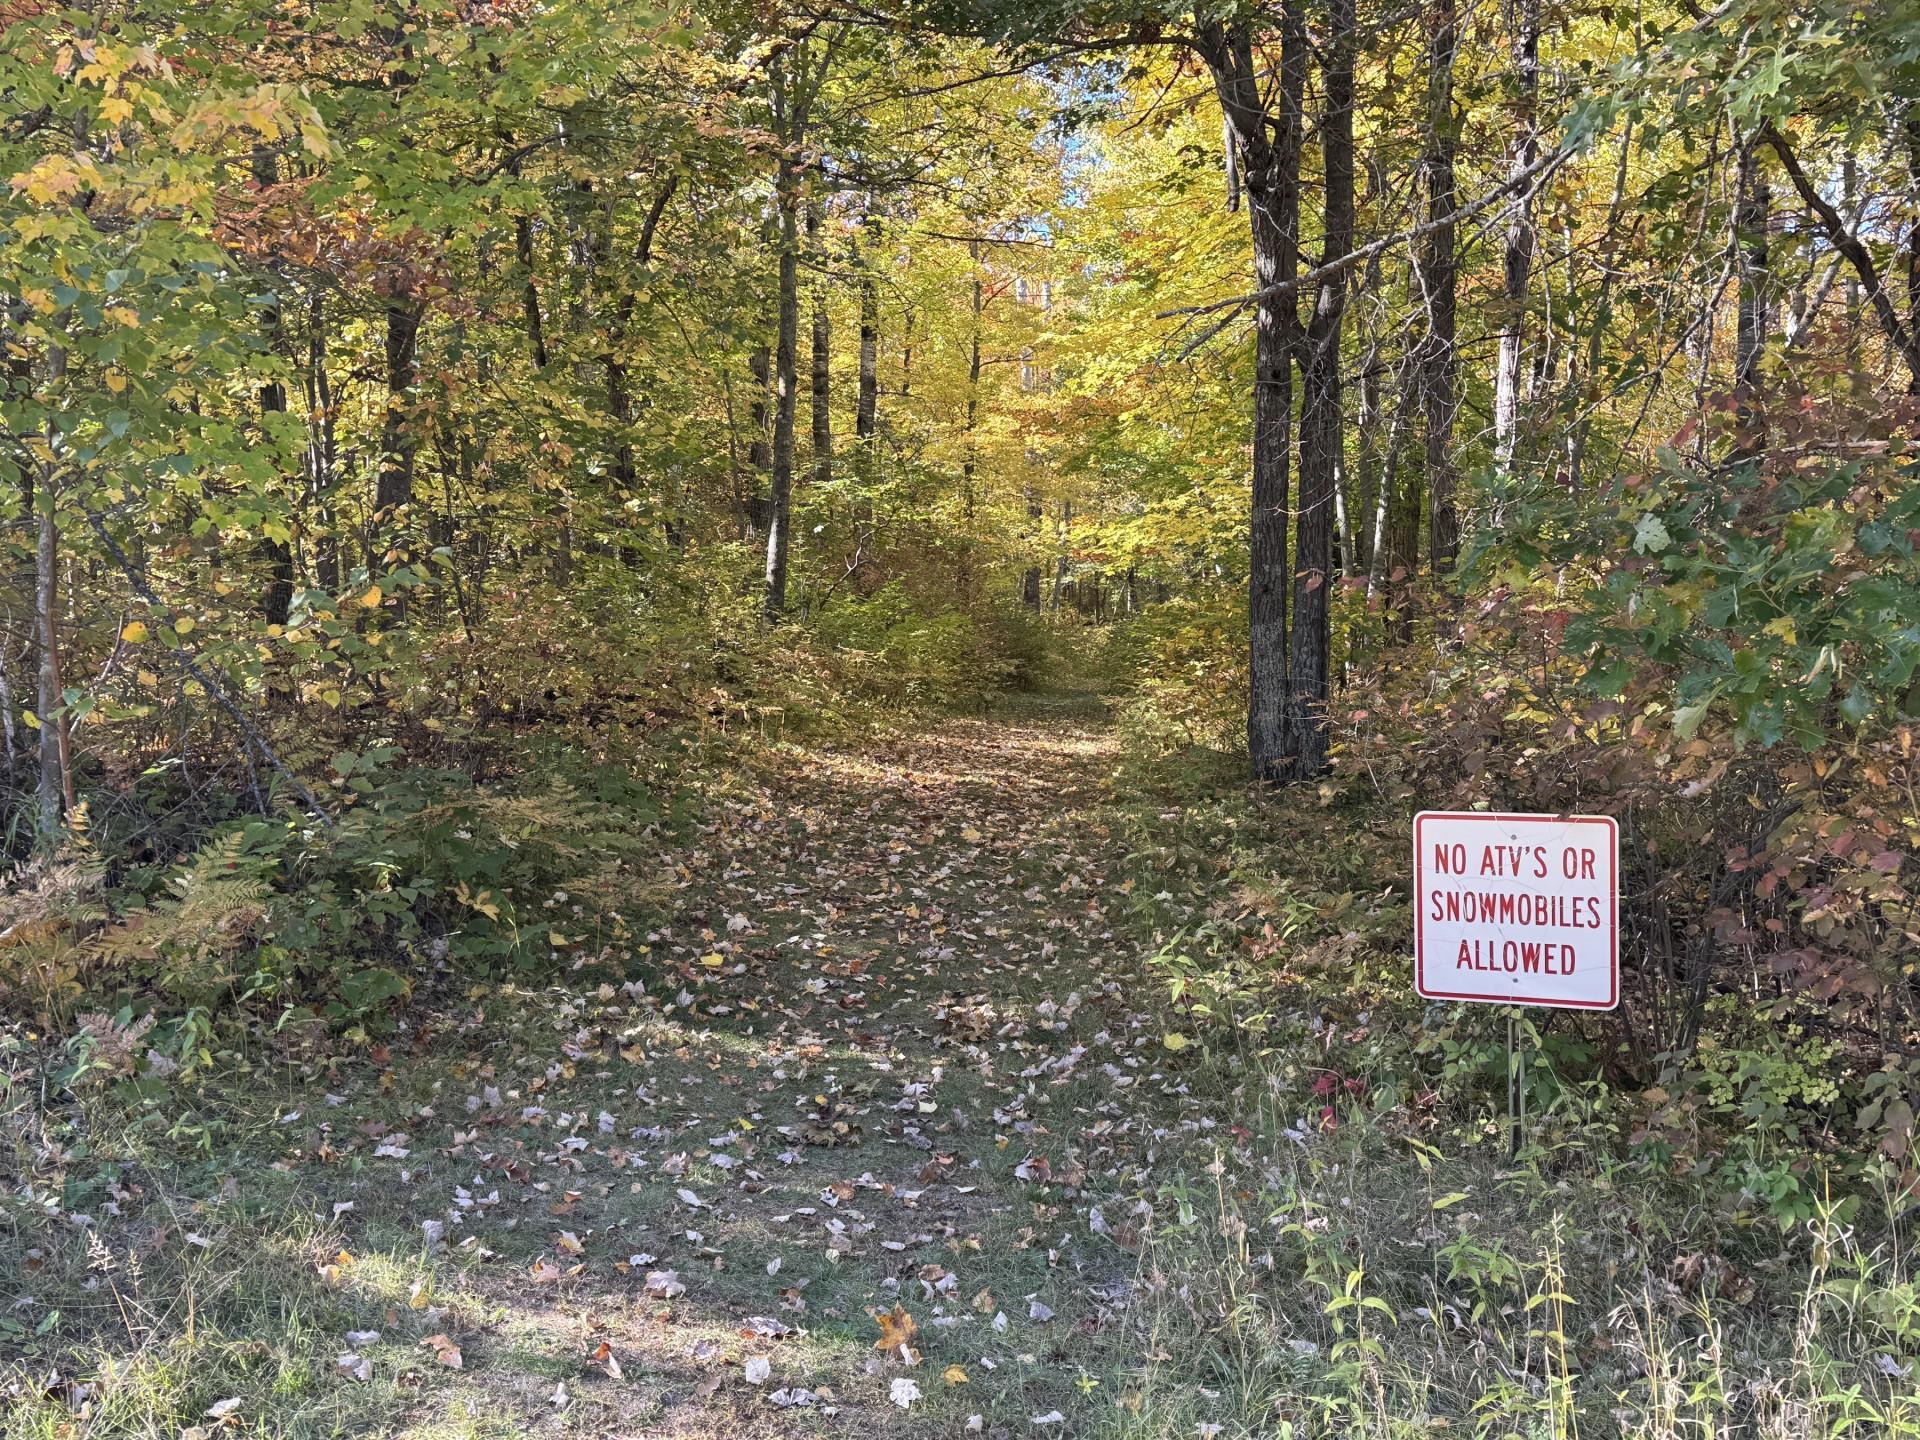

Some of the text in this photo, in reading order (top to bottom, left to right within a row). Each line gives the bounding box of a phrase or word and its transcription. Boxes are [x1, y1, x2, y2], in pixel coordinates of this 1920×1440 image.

[1434, 843, 1596, 880] NO ATV'S OR
[1431, 890, 1601, 929] SNOWMOBILES
[1456, 939, 1576, 976] ALLOWED
